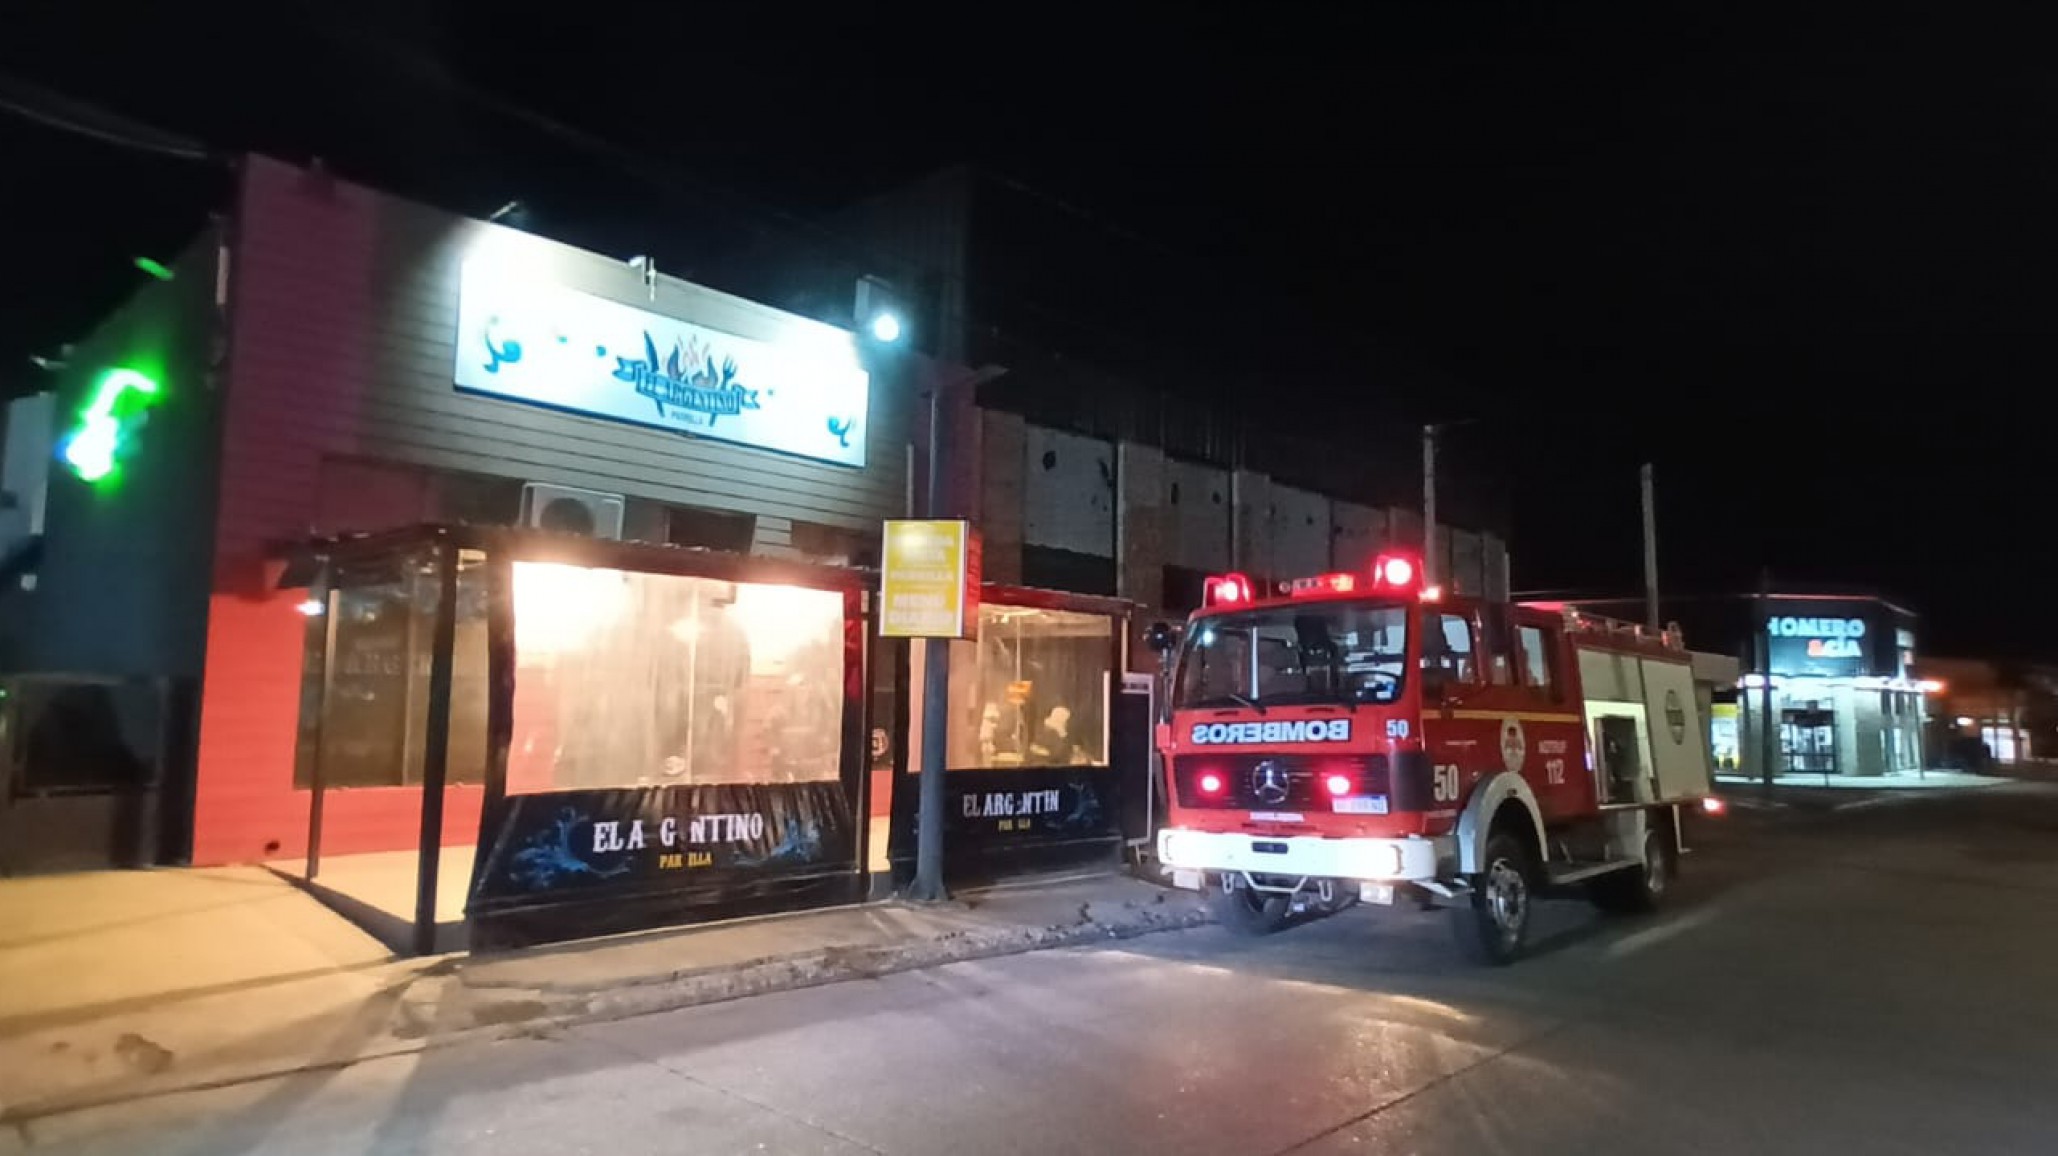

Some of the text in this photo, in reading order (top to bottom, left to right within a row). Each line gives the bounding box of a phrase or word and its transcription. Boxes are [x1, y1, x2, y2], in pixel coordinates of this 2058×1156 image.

[1386, 719, 1409, 739] 50
[1433, 764, 1459, 801] 50
[1546, 759, 1564, 784] 112
[593, 813, 764, 853] EL AGNTINO
[659, 852, 712, 869] PARILLA
